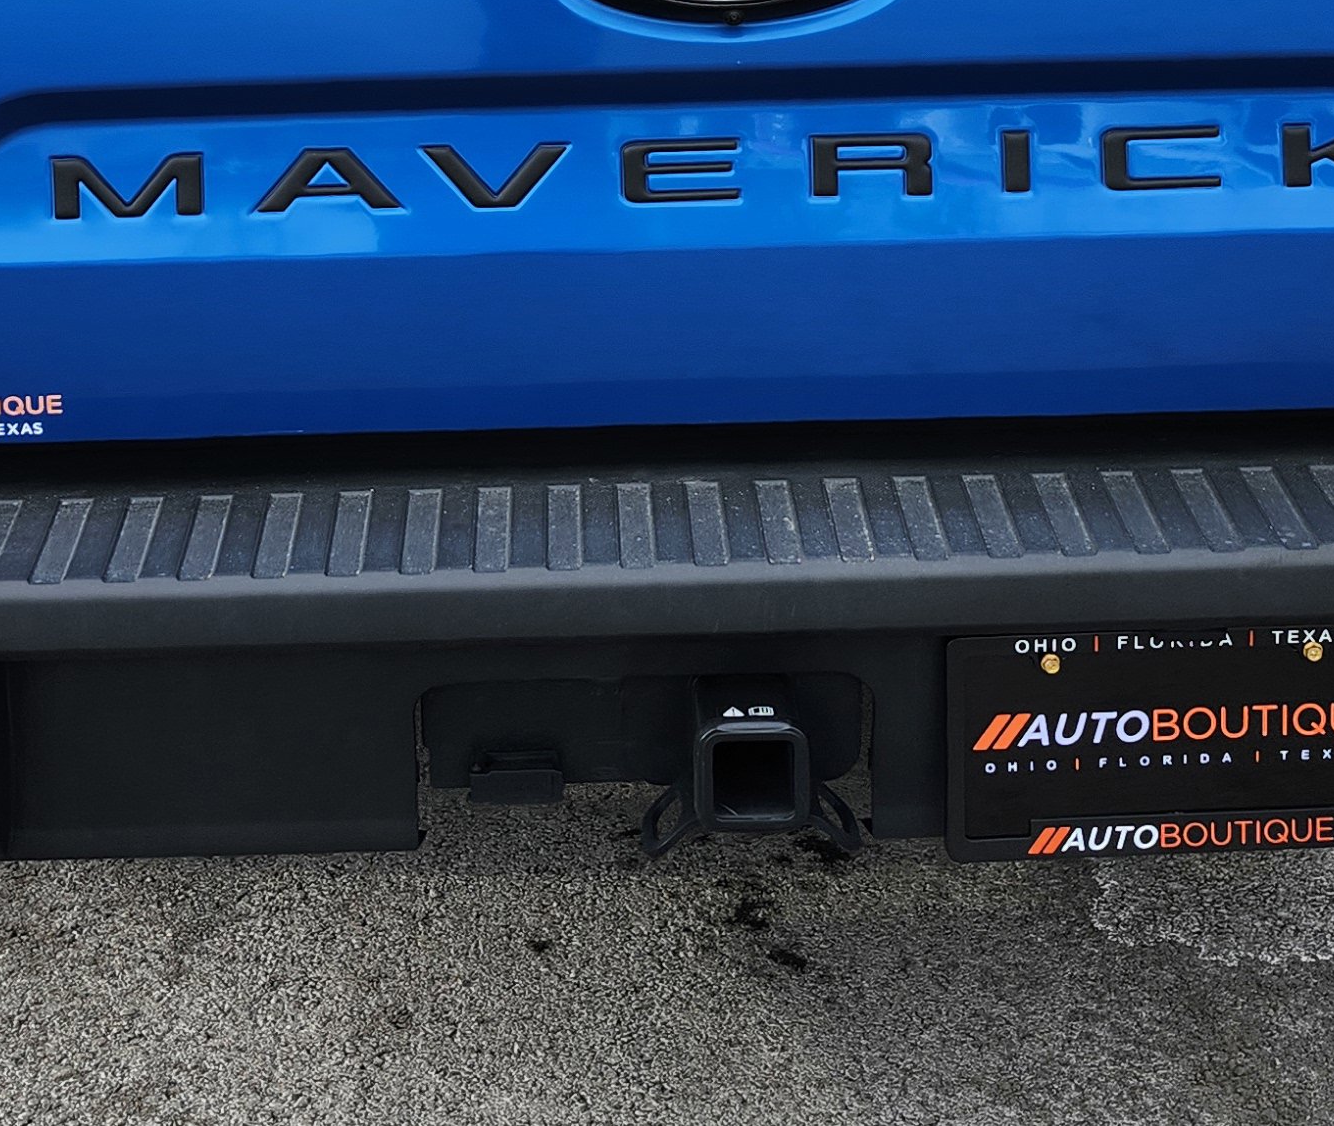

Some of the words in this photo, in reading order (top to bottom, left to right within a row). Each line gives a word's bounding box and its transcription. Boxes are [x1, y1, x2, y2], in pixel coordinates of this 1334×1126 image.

[1014, 637, 1077, 654] OHIO
[984, 759, 1058, 774] OHIO
[1099, 752, 1233, 768] FLORIDA
